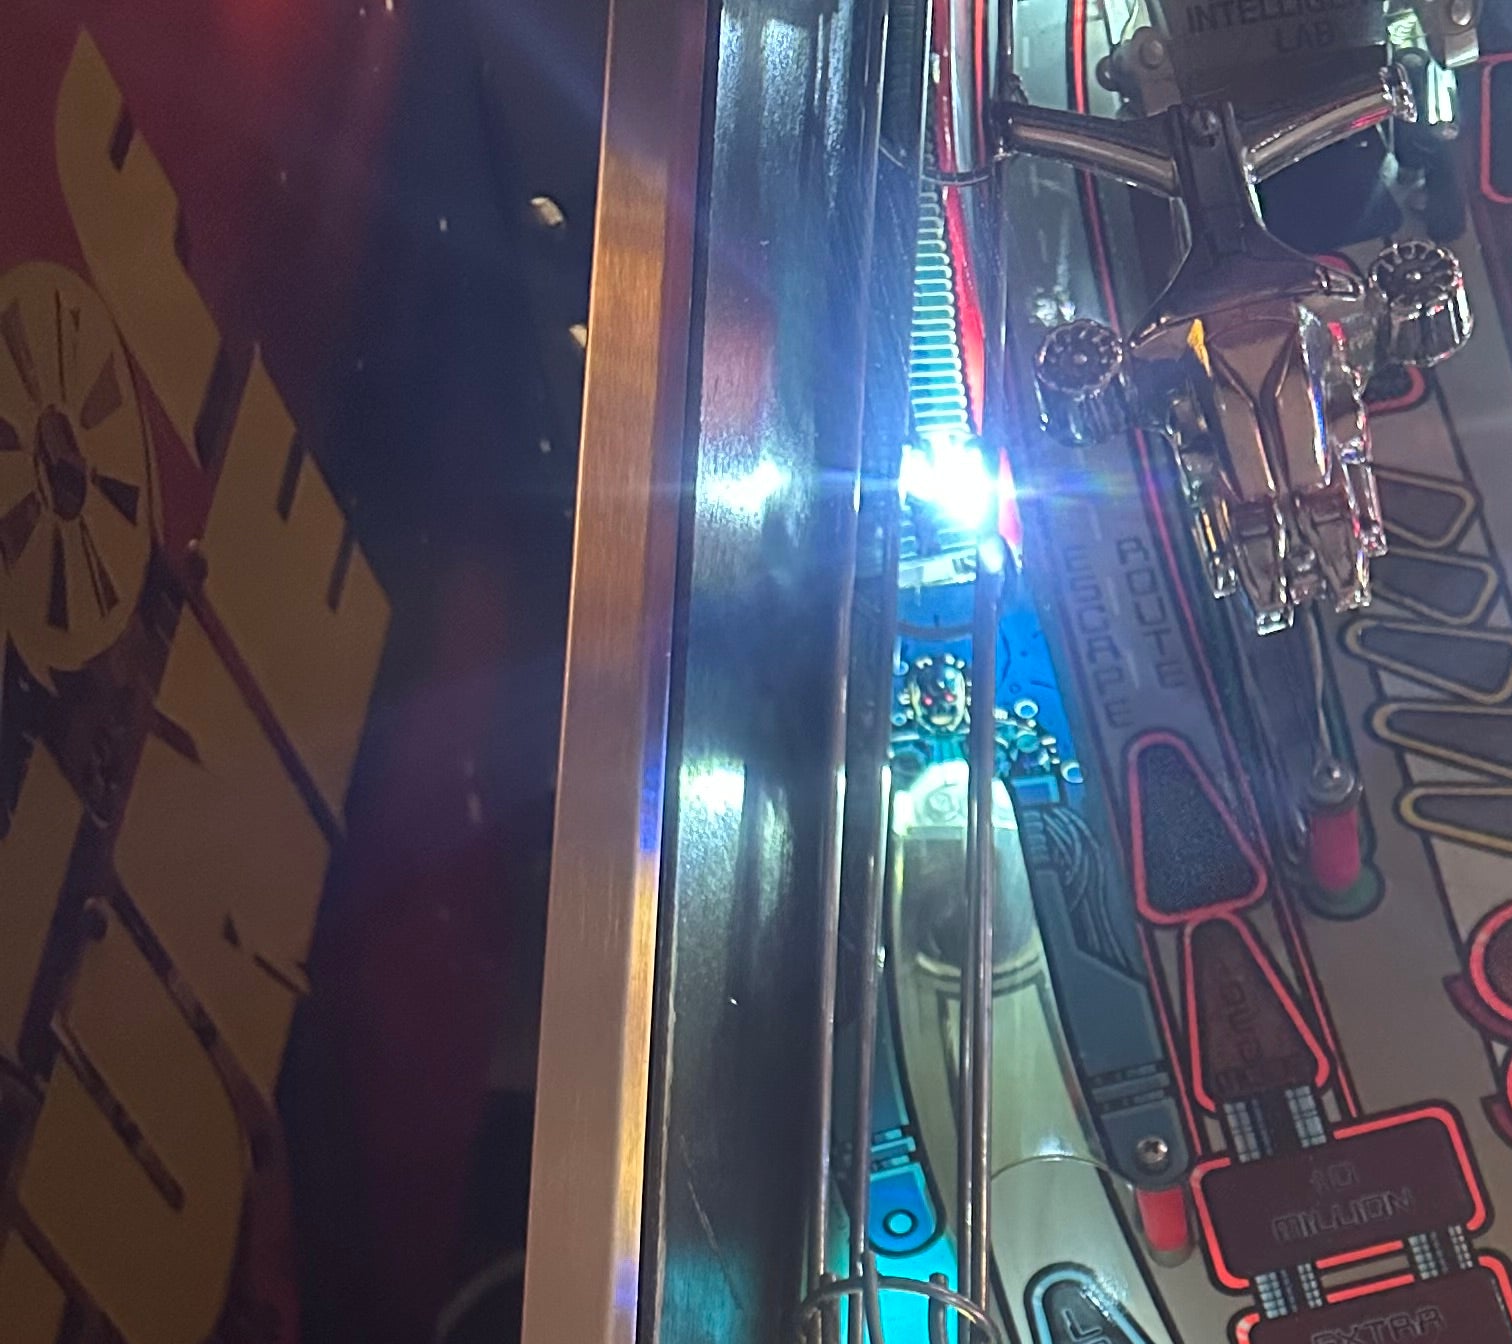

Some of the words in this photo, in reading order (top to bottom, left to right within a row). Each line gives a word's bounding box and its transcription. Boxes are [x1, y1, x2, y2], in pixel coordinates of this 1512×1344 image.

[1064, 545, 1134, 728] ESCAPE
[1117, 536, 1184, 689] ROUTE
[1273, 1188, 1412, 1242] MILLION
